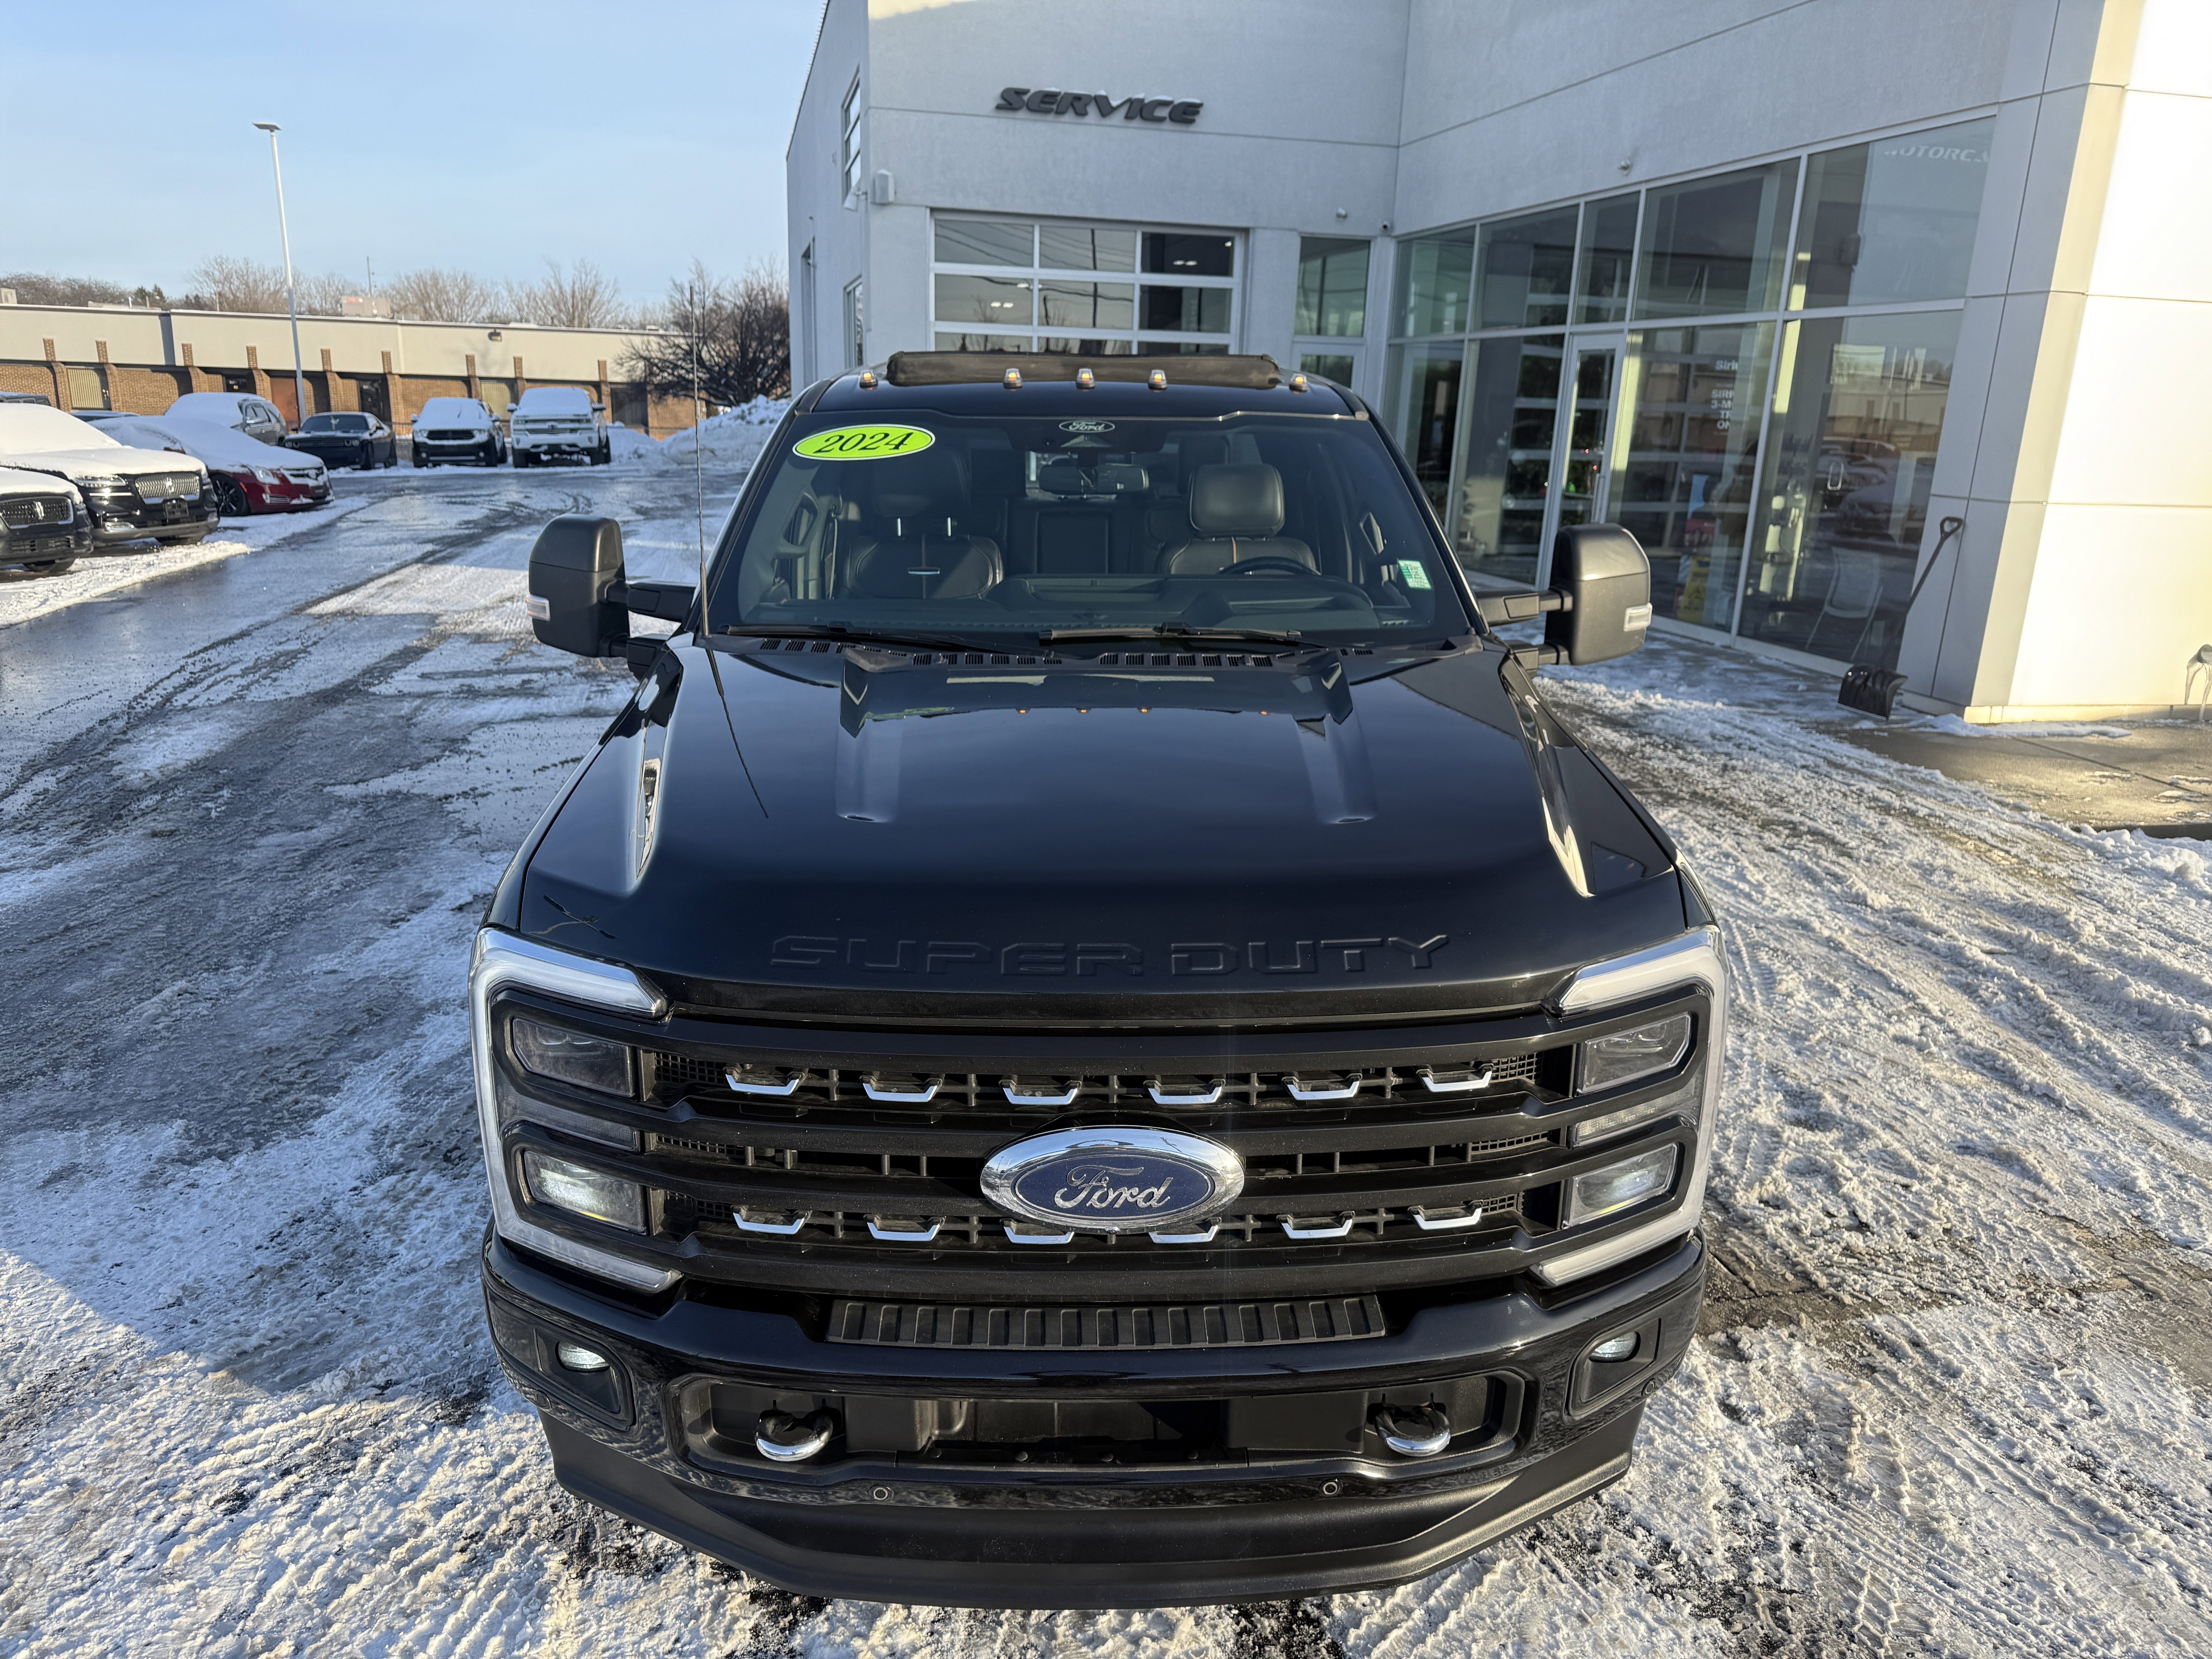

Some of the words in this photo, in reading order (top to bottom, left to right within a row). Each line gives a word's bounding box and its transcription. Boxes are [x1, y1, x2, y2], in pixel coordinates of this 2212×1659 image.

[996, 87, 1204, 124] SERVICE
[1711, 389, 1735, 399] SIRI
[1069, 421, 1105, 431] Ford
[812, 432, 914, 454] 2024
[770, 935, 1143, 976] SUPER
[1171, 934, 1449, 975] DUTY
[1054, 1164, 1173, 1209] Ford
